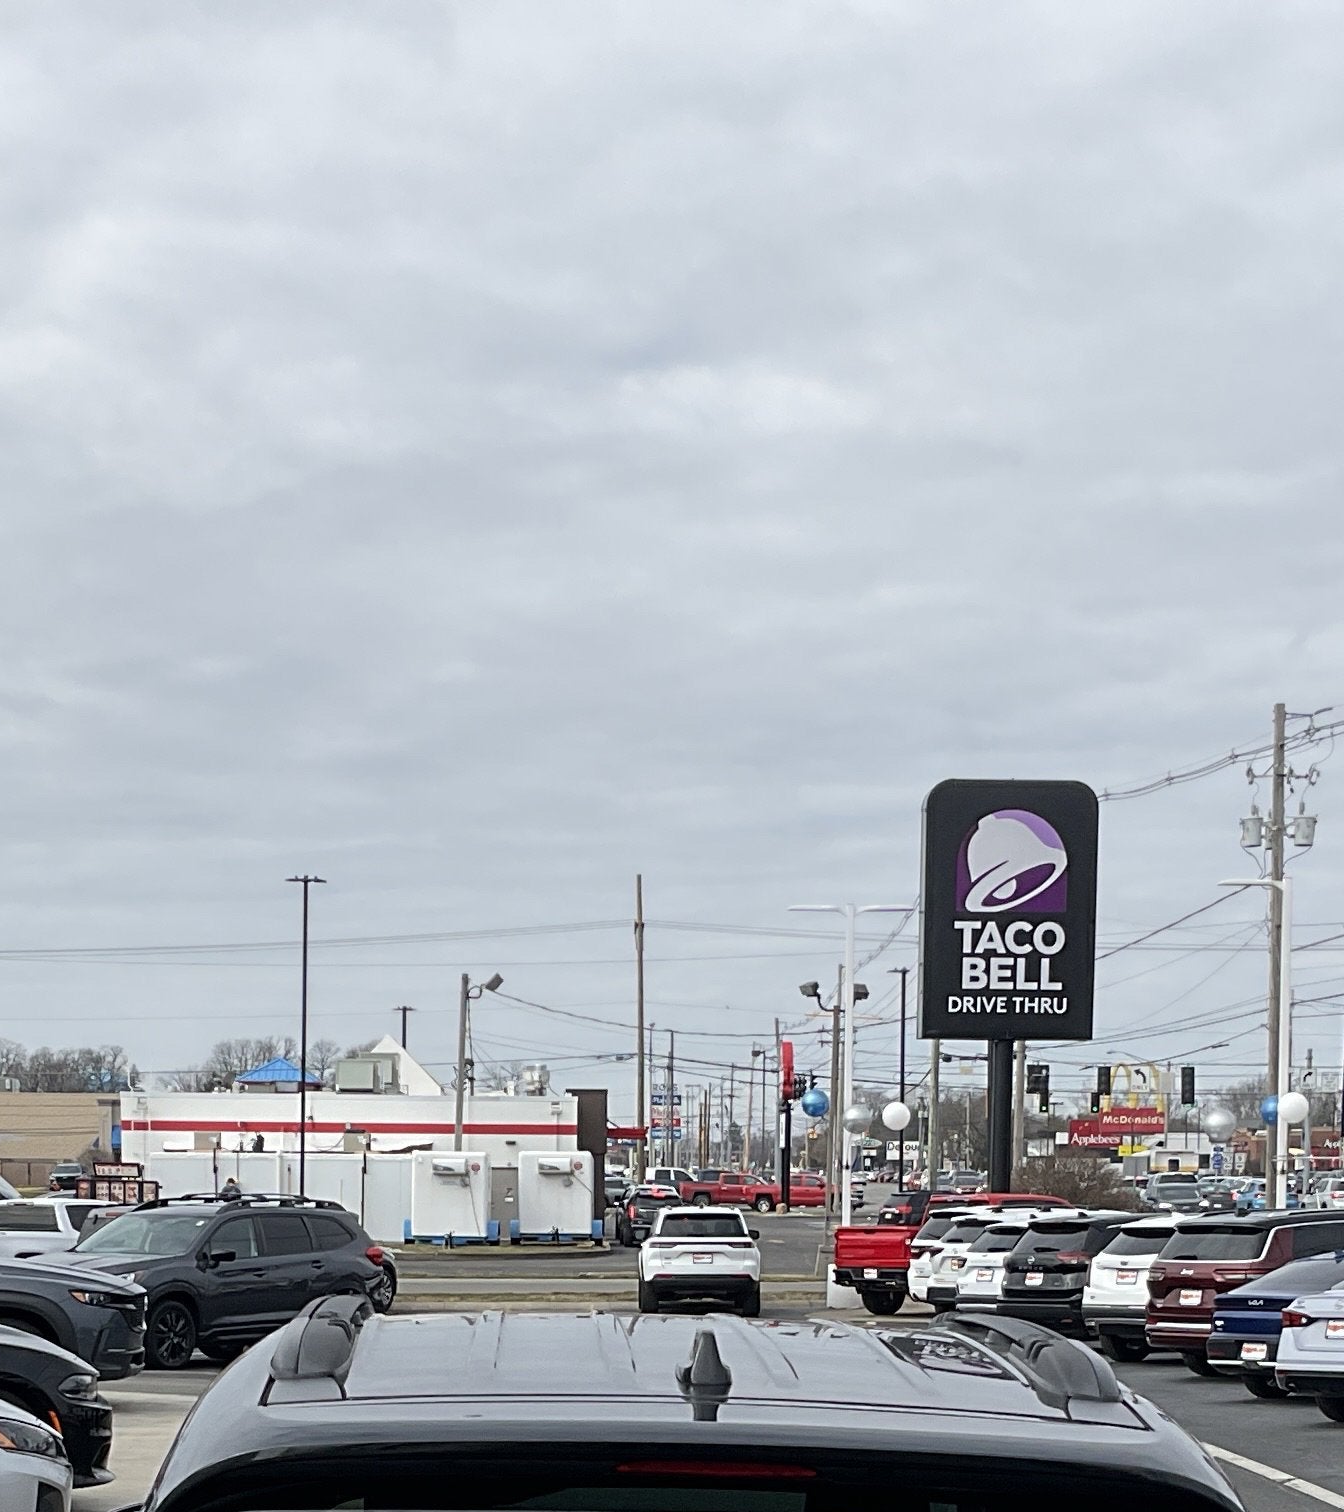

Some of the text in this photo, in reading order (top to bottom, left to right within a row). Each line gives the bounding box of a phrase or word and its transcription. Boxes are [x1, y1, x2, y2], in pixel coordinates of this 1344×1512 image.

[954, 921, 1065, 955] TACO
[961, 957, 1063, 991] BELL
[947, 996, 1068, 1014] DRIVE THRU
[1102, 1115, 1164, 1124] McDonald's
